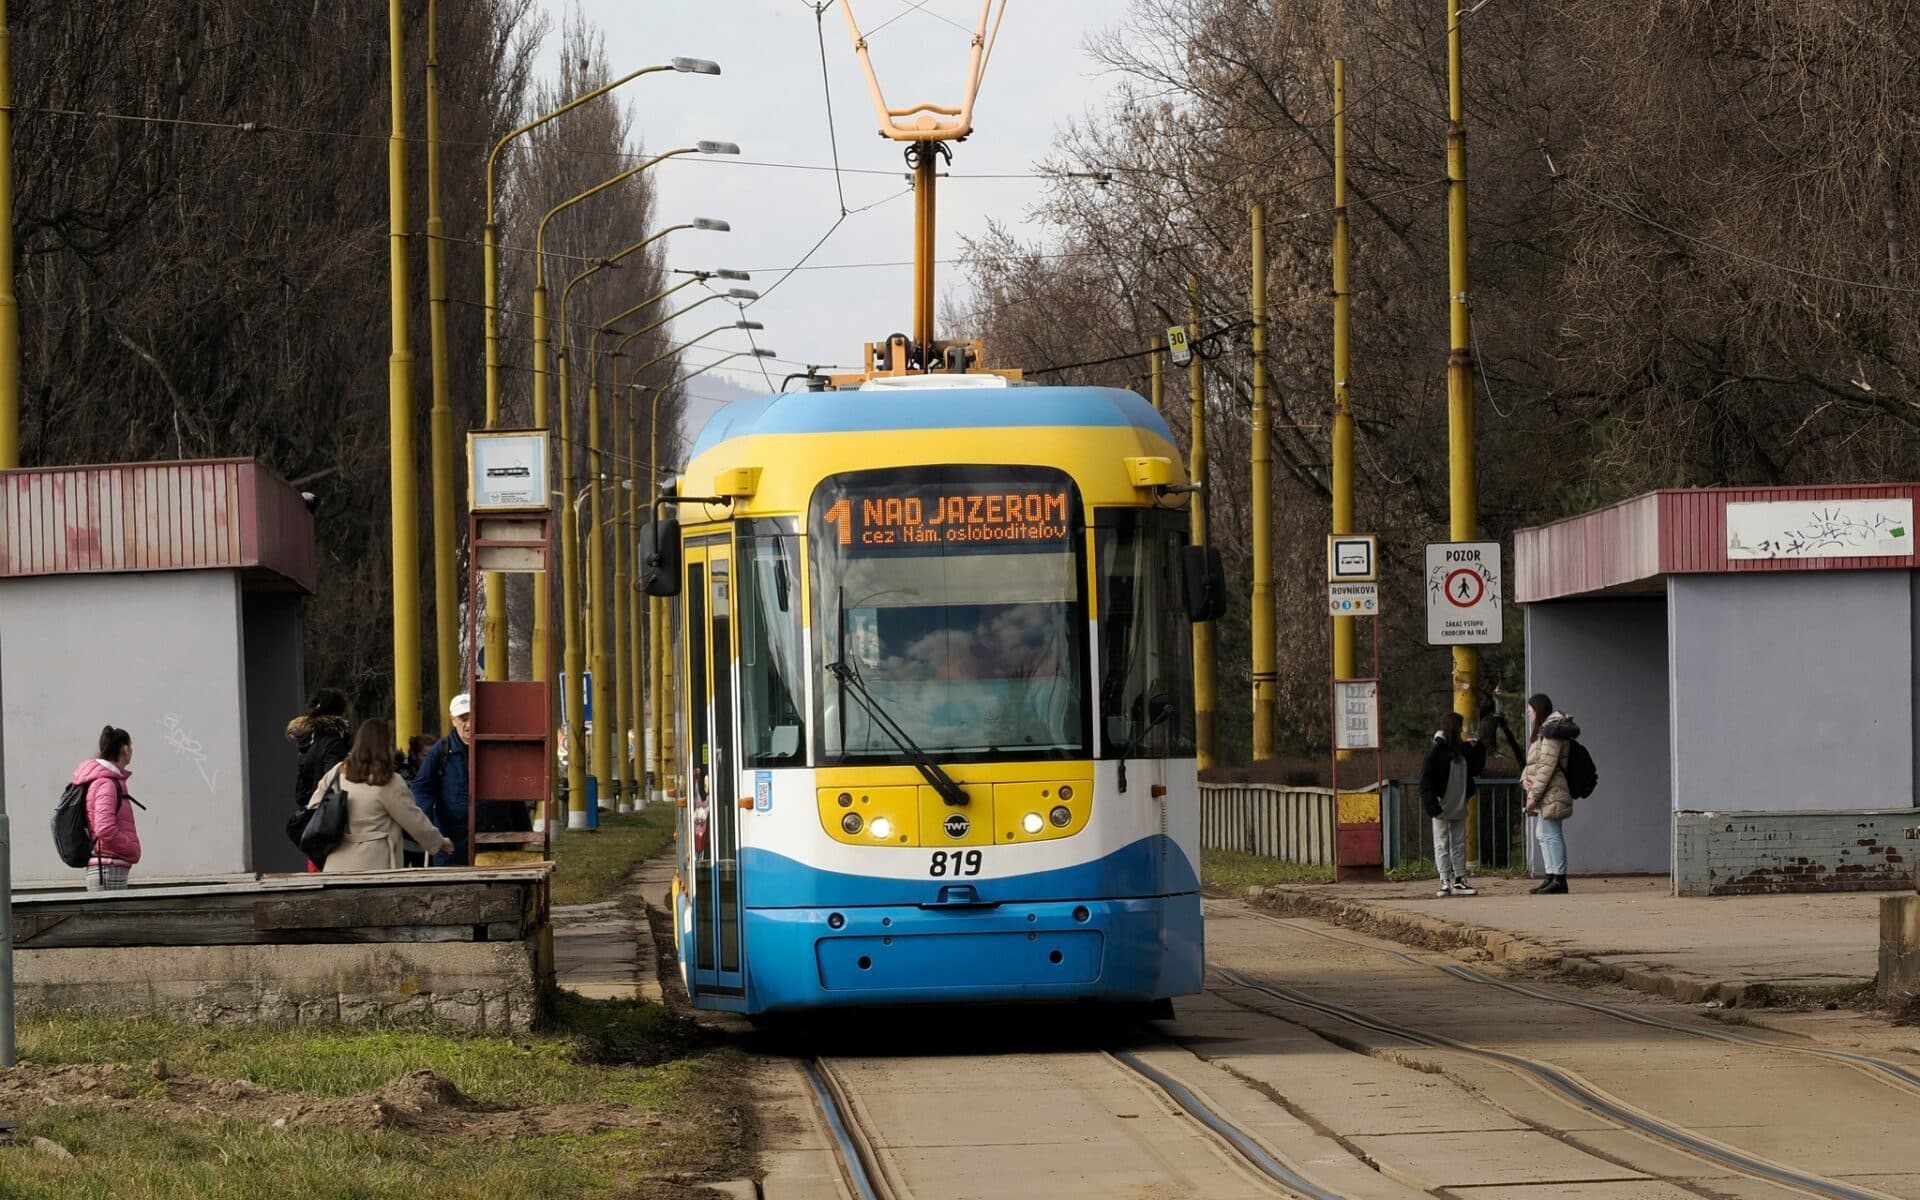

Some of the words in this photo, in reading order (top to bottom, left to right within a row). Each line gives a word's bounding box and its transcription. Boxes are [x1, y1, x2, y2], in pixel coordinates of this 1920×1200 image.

[1170, 332, 1184, 345] 30
[863, 497, 922, 526] NAD
[929, 493, 1067, 525] JAZEROM
[824, 499, 852, 545] 1
[862, 530, 894, 545] cez
[903, 525, 942, 543] Nám.
[1446, 550, 1481, 562] POZOR
[1332, 585, 1375, 595] ROVNÍKOVA
[1445, 620, 1462, 628] ZÁKAZ
[945, 822, 969, 831] TWT
[929, 850, 982, 877] 819
